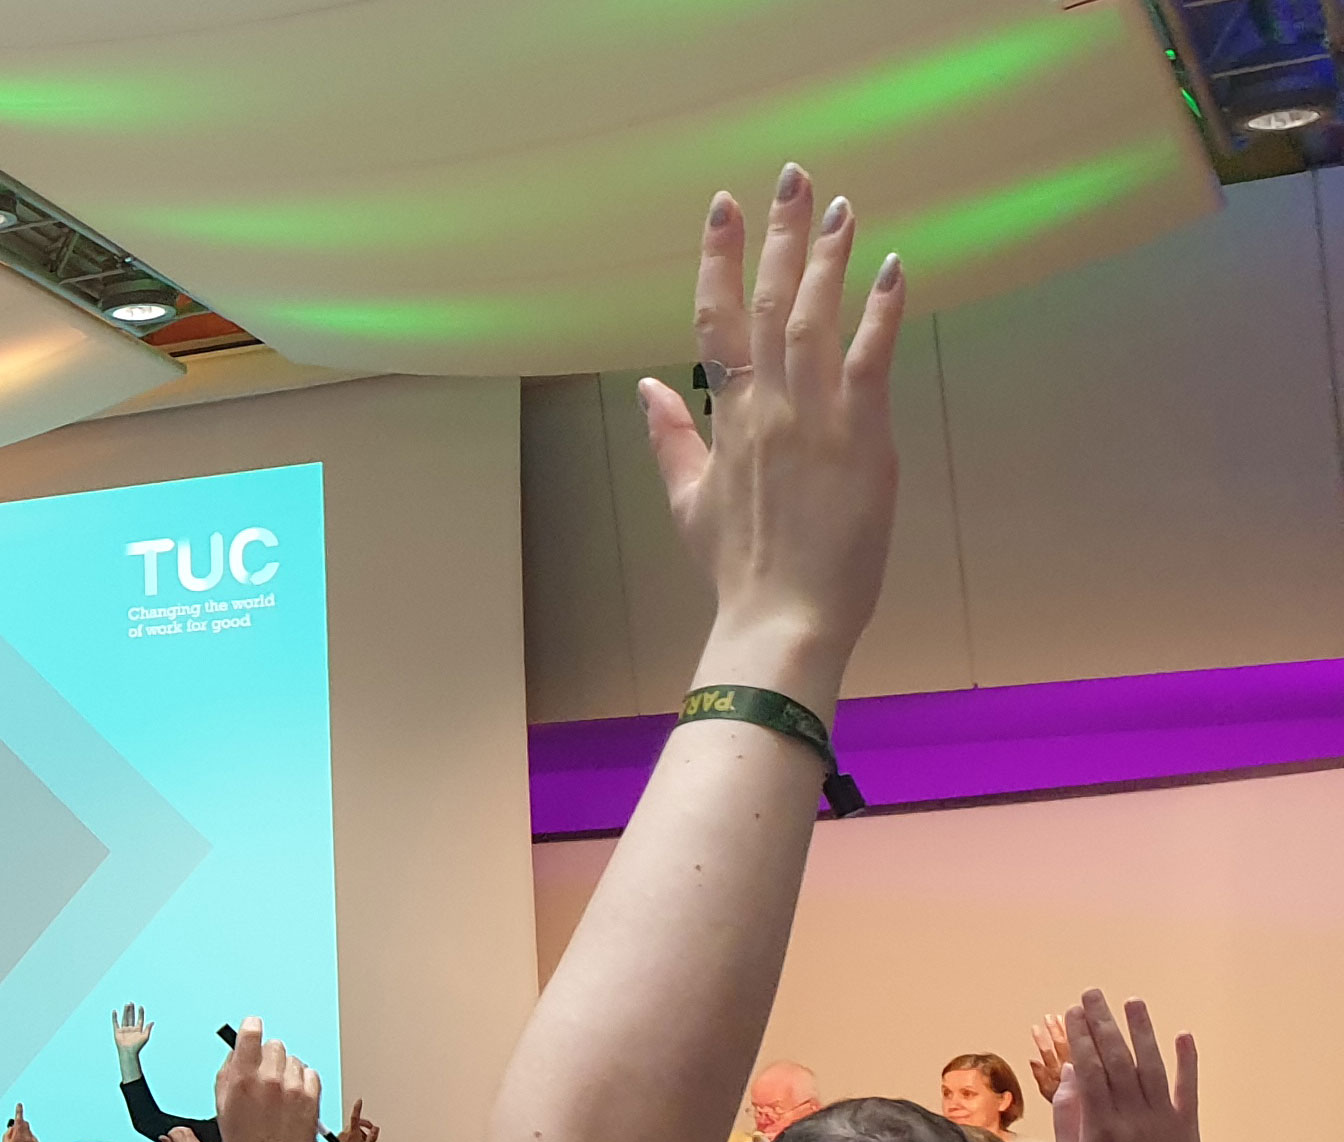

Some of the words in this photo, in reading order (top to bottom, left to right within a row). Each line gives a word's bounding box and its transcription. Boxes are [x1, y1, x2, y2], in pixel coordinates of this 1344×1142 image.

[125, 527, 280, 596] TUC
[127, 604, 202, 620] Changing
[205, 599, 229, 613] the
[232, 592, 276, 609] world
[128, 624, 143, 638] of
[145, 621, 183, 636] work
[187, 618, 208, 632] for
[212, 614, 252, 633] good
